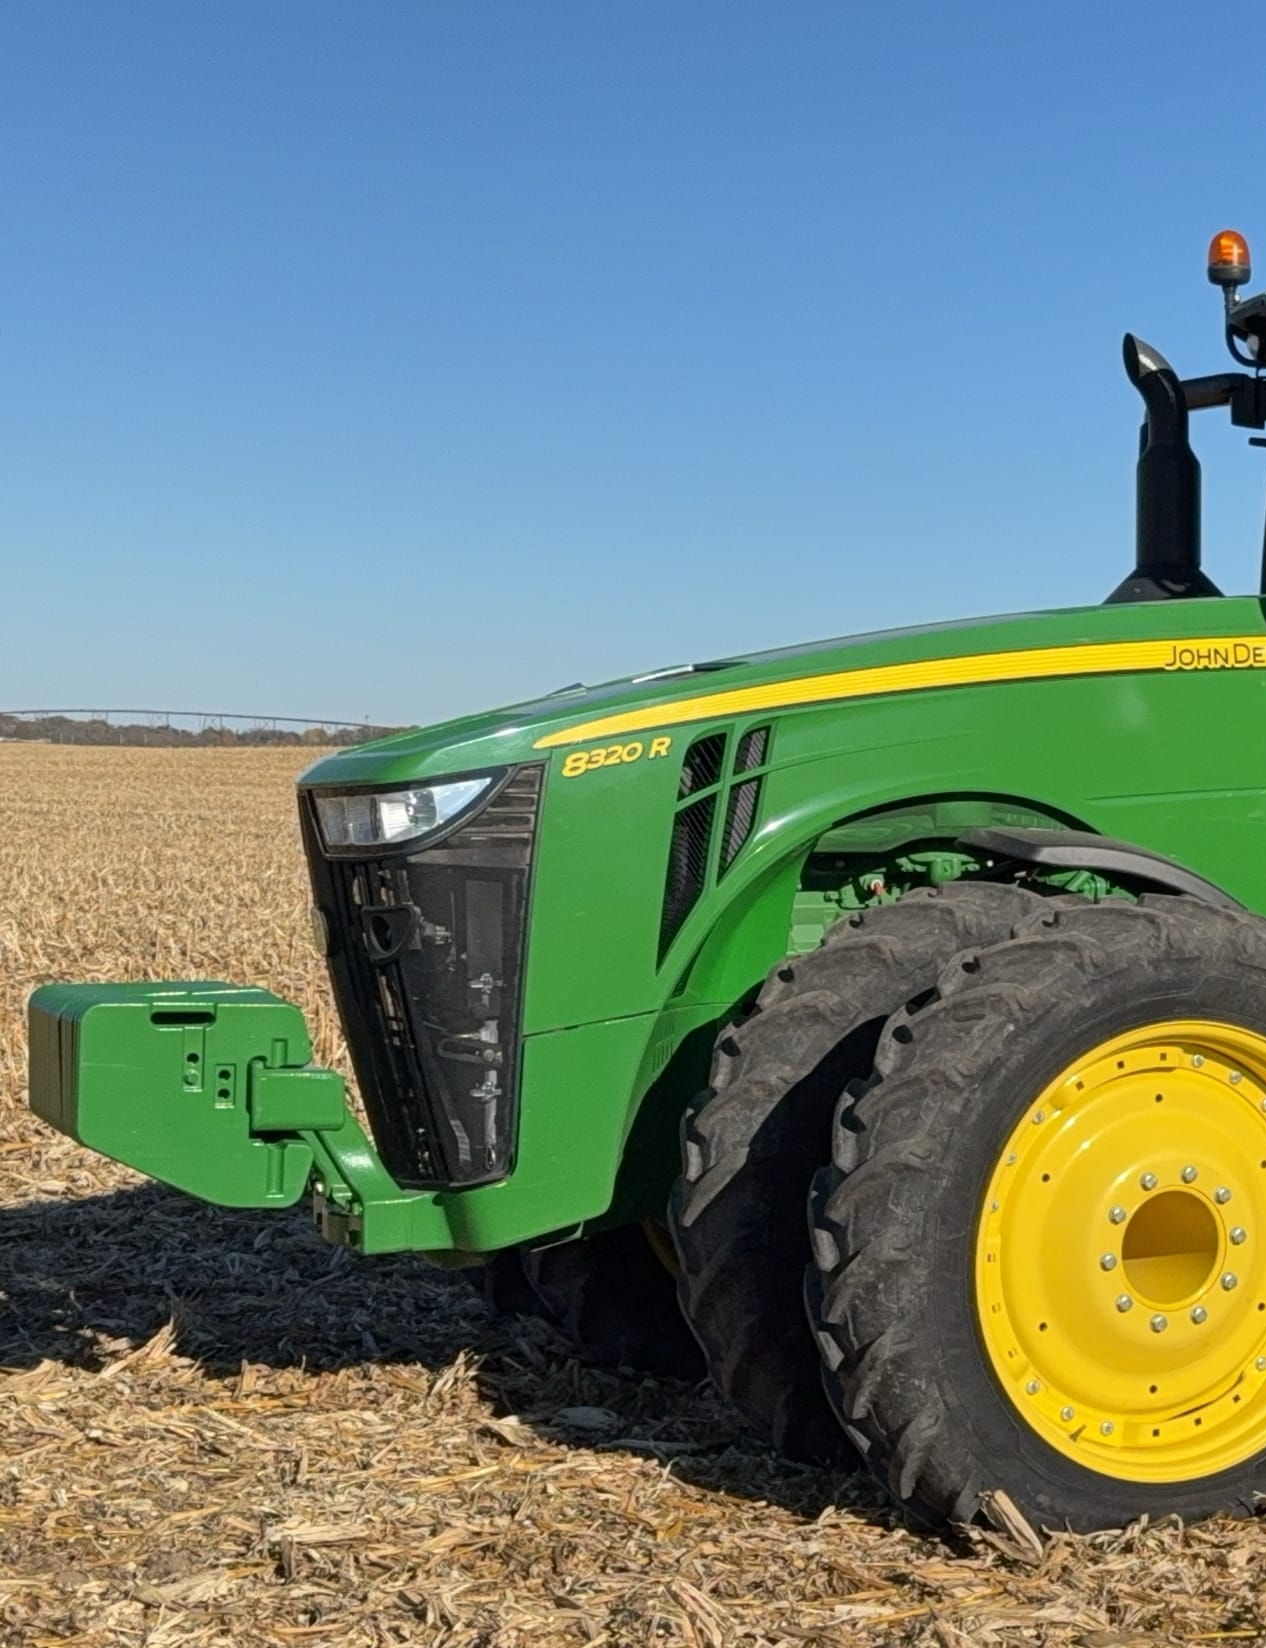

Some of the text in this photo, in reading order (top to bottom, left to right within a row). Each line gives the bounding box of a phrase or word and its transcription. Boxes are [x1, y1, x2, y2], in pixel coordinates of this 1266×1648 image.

[1165, 645, 1228, 667] JOHN
[561, 736, 672, 778] 8320 R
